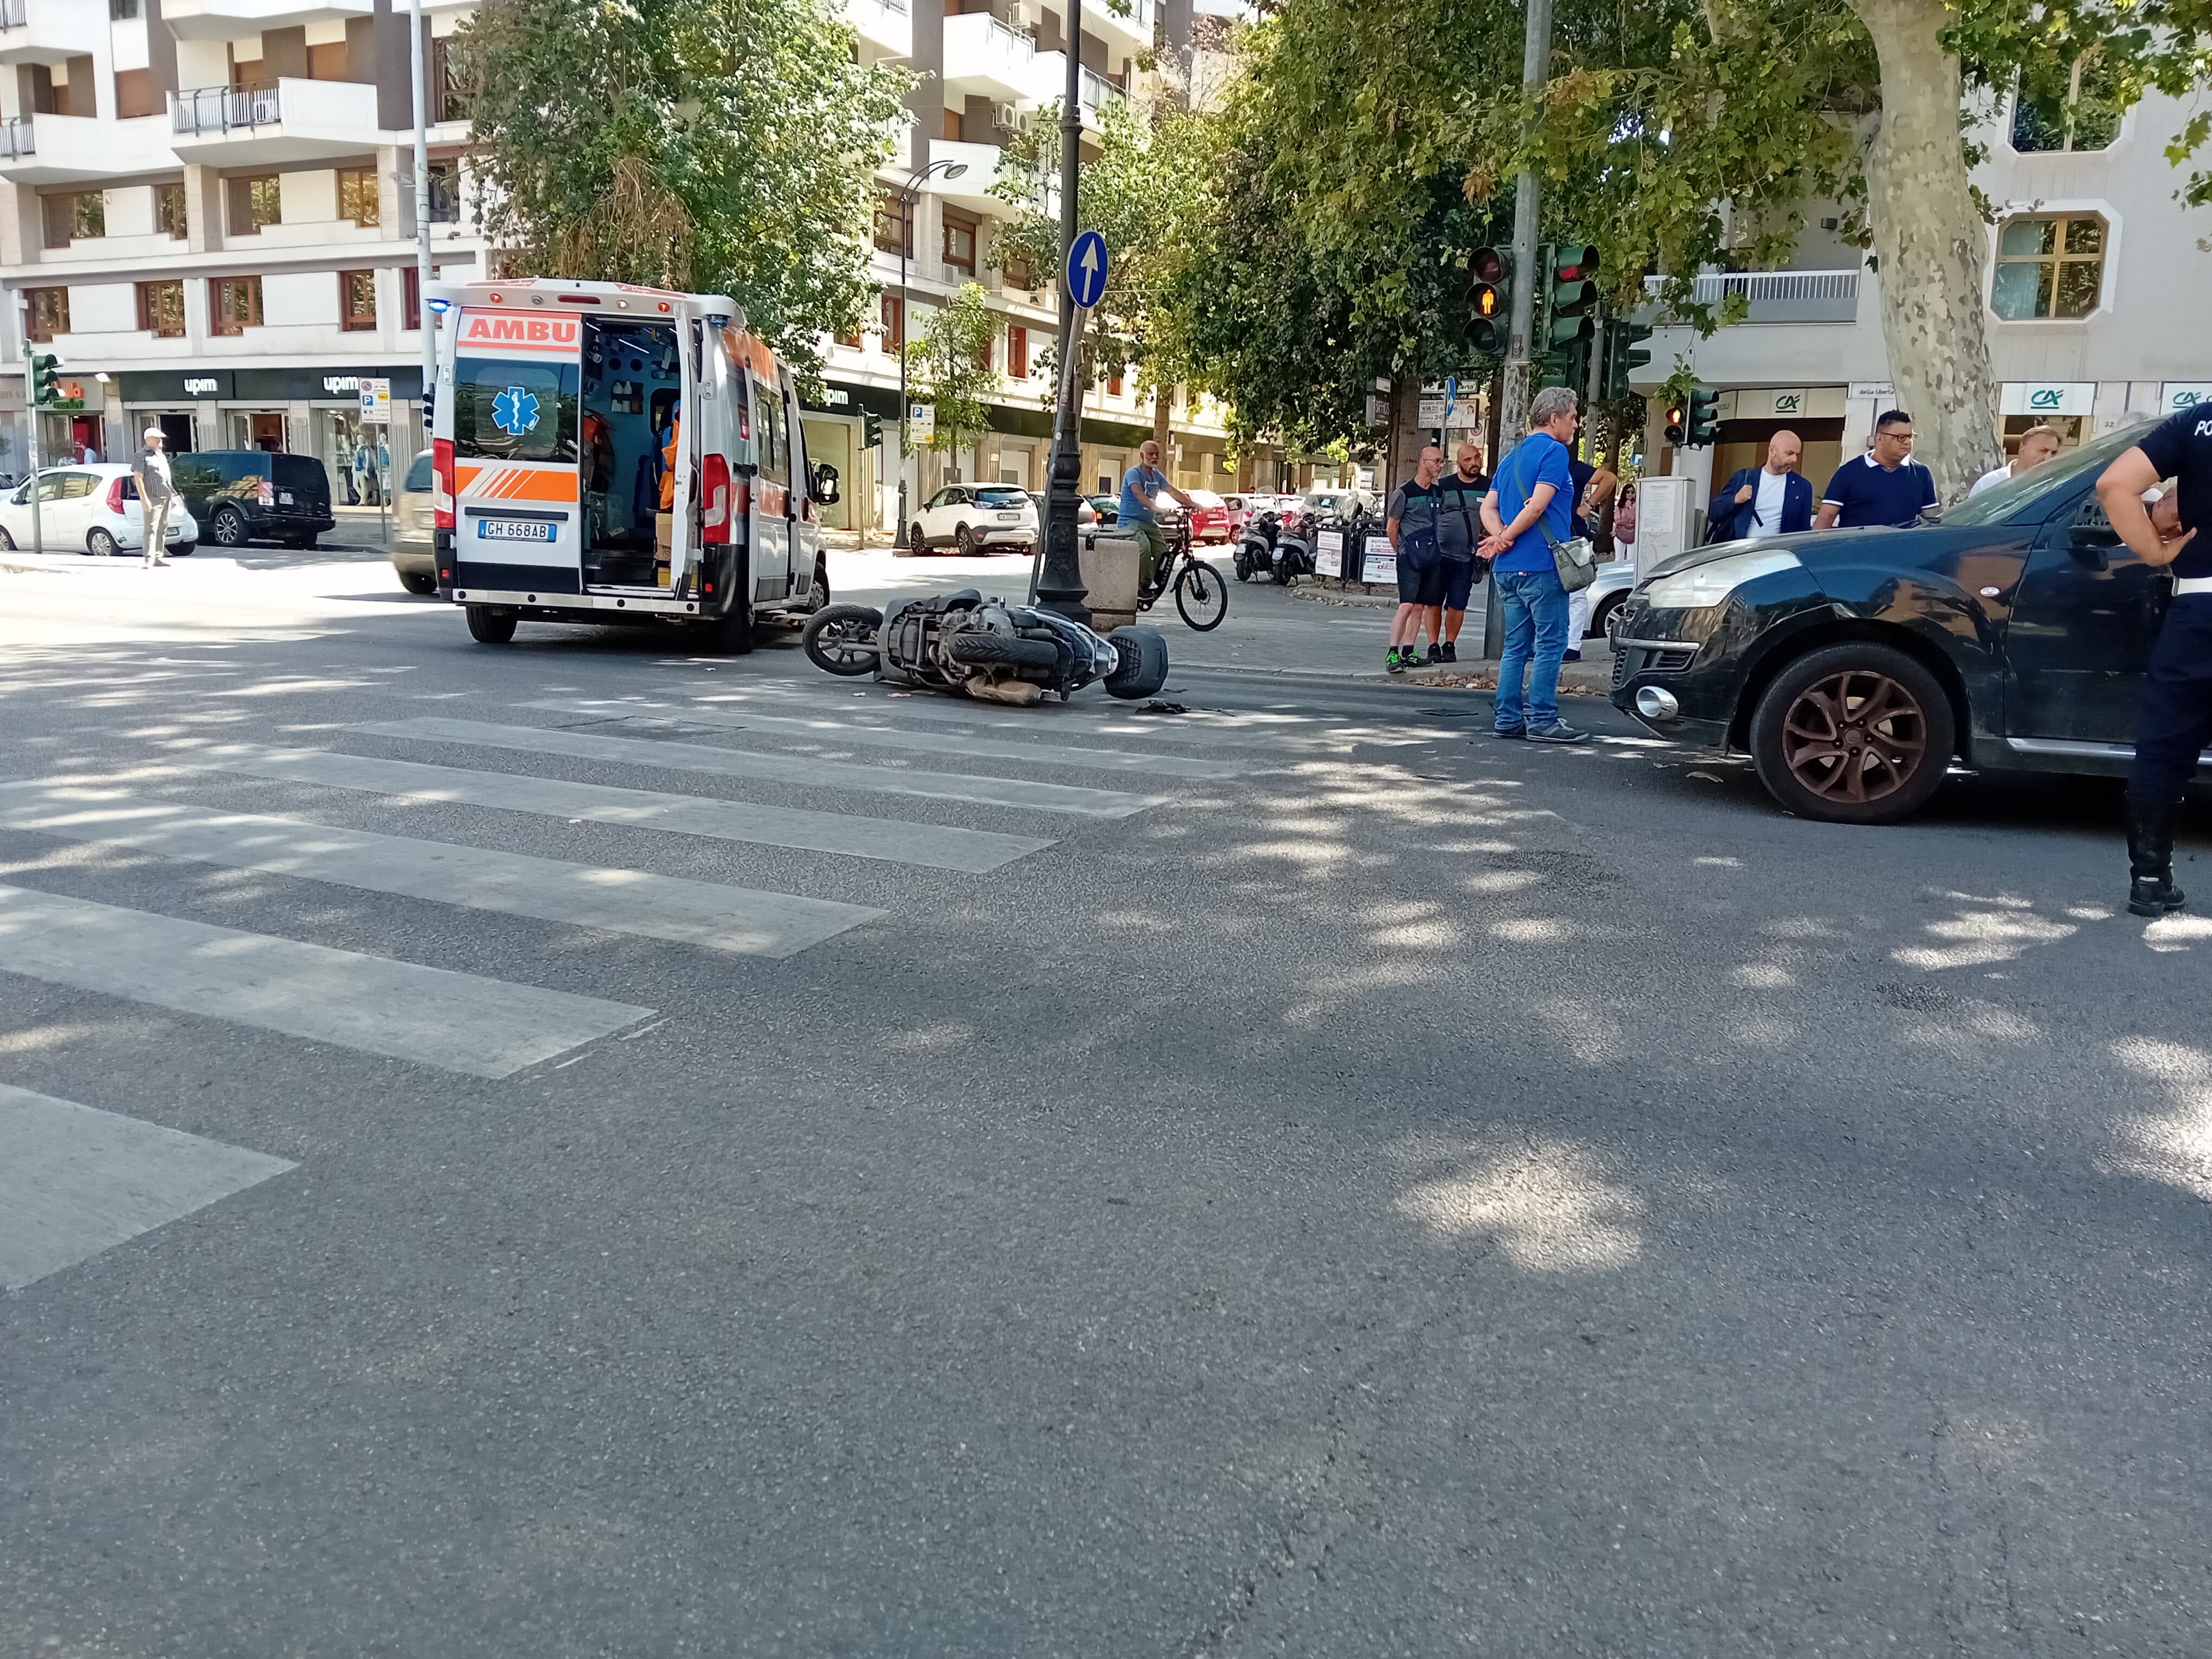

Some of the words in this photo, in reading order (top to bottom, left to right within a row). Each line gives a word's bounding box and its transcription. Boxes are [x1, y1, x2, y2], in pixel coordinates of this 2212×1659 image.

[467, 318, 576, 342] AMBU
[183, 378, 218, 395] upim
[324, 376, 359, 395] upim
[2194, 420, 2212, 436] PO
[488, 523, 503, 535] GH
[507, 524, 546, 538] 668AB
